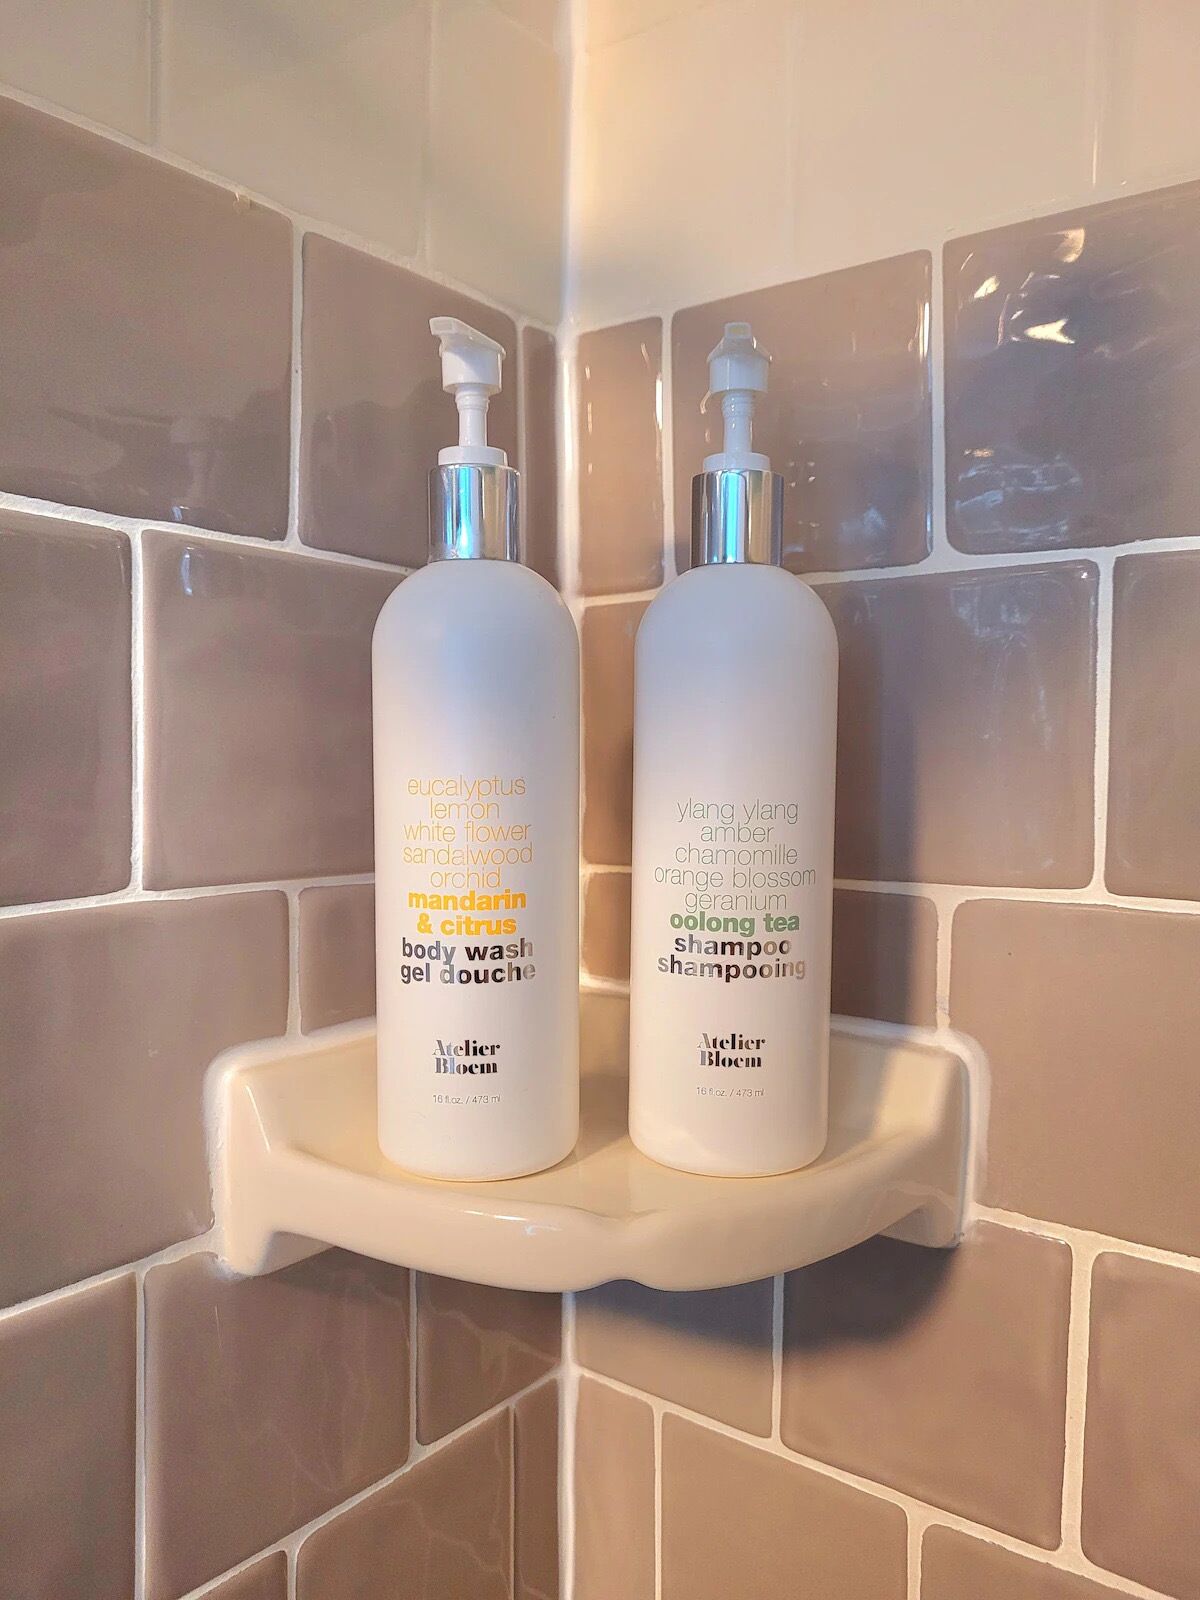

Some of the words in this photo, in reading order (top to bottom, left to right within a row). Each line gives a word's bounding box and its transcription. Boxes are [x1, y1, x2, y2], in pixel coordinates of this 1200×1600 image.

[407, 774, 526, 801] eucalyptus
[430, 797, 500, 819] lemon
[677, 798, 735, 825] ylang
[743, 798, 798, 825] ylang
[403, 820, 456, 842] white
[464, 820, 532, 842] flower
[700, 821, 775, 843] amber
[402, 842, 533, 865] sandalwood
[675, 842, 798, 866] chamomille
[430, 867, 501, 888] orchid
[654, 867, 724, 892] orange
[733, 867, 816, 888] blossom
[408, 888, 526, 911] mandarin
[685, 890, 787, 914] geranium
[416, 913, 433, 934] &
[440, 915, 517, 936] citrus
[670, 911, 755, 938] oolong
[763, 913, 800, 933] tea
[402, 937, 456, 965] body
[465, 937, 534, 961] wash
[674, 934, 792, 960] shampoo
[400, 963, 430, 984] gel
[439, 962, 536, 984] douche
[657, 954, 806, 983] shampooing
[432, 1039, 501, 1057] Atelier
[697, 1033, 766, 1050] Atelier
[434, 1057, 498, 1075] Bloem
[699, 1050, 762, 1068] Bloem
[432, 1094, 443, 1104] 16
[472, 1094, 489, 1104] 473
[491, 1094, 501, 1103] ml
[696, 1087, 707, 1096] 16
[736, 1088, 753, 1098] 473
[754, 1087, 764, 1097] ml
